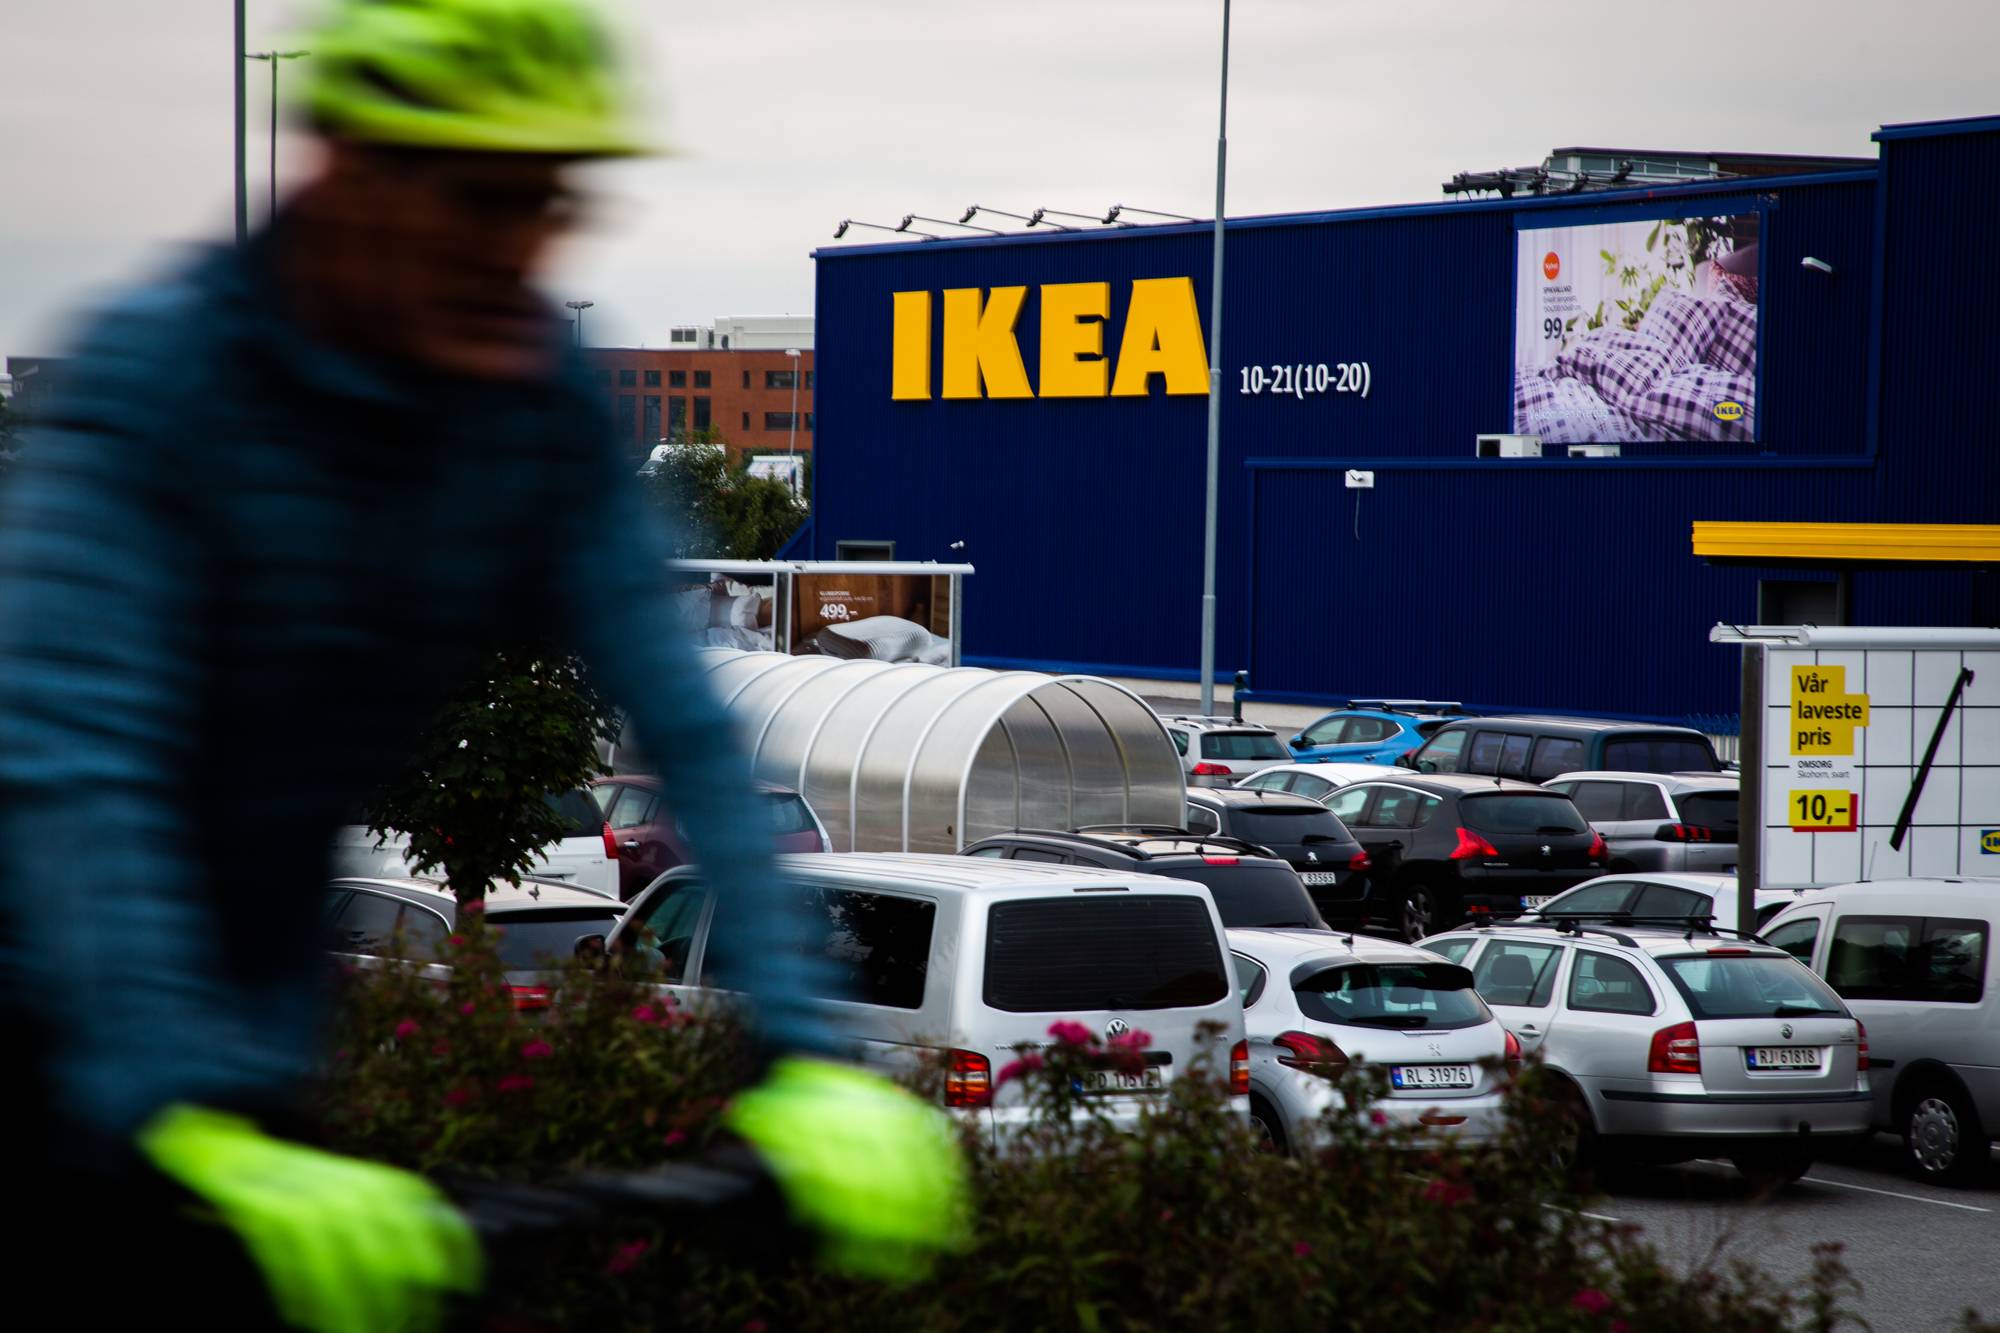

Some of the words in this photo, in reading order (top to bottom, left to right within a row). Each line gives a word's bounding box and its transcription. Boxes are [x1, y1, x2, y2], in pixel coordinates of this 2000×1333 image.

[892, 276, 1211, 401] IKEA
[1240, 362, 1371, 400] 10-21(10-20)
[1797, 672, 1829, 693] Vår
[1797, 701, 1862, 719] laveste
[1797, 727, 1831, 750] pris
[1797, 760, 1833, 769] OMSORG
[1759, 1050, 1774, 1064] RJ
[1780, 1050, 1815, 1064] 61818
[1405, 1068, 1423, 1083] RL
[1428, 1067, 1466, 1083] 31976
